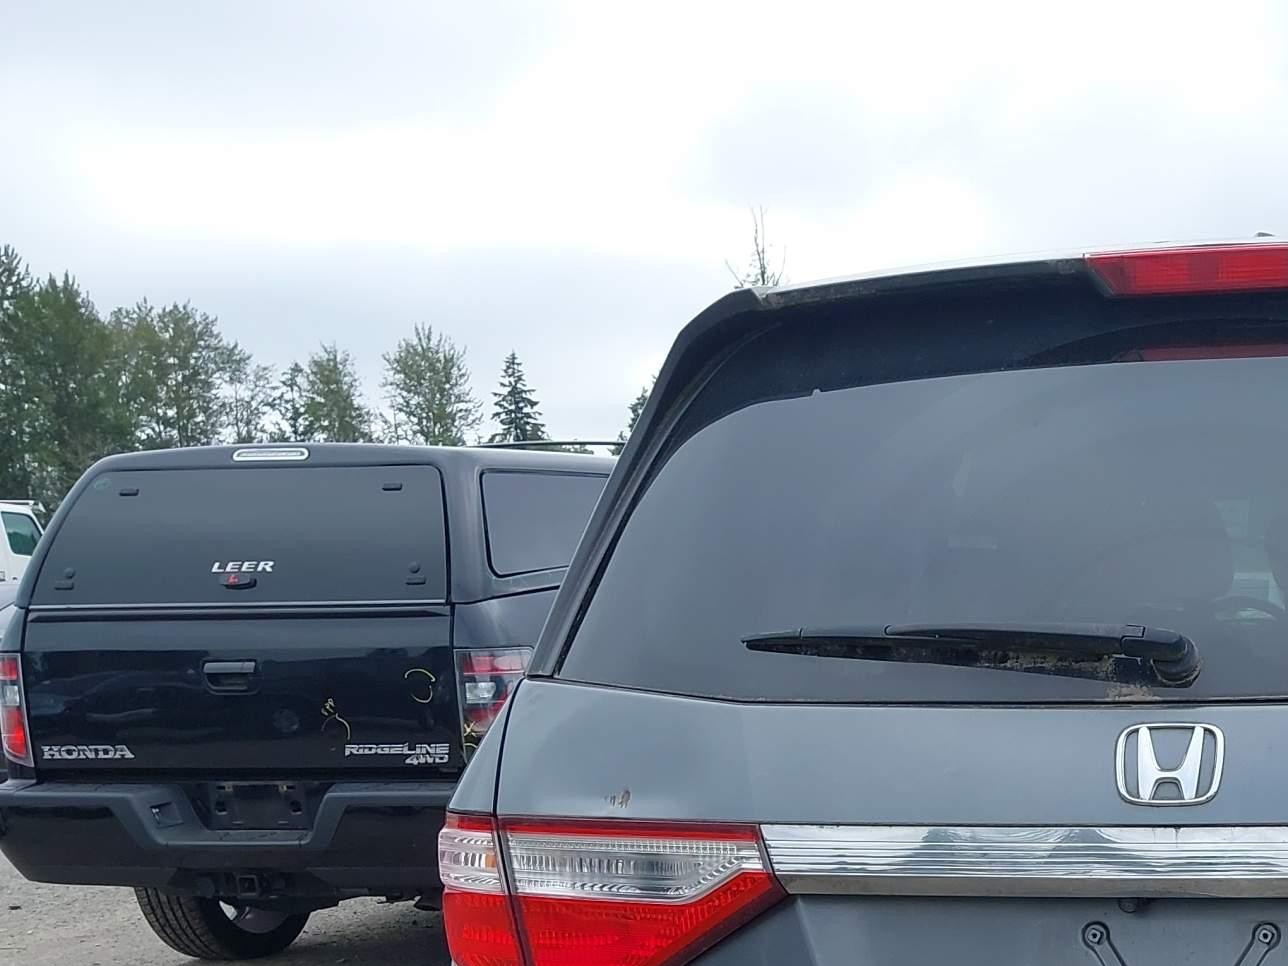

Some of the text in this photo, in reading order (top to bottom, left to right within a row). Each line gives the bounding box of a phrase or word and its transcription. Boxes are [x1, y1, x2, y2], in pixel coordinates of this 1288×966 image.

[210, 560, 275, 573] LEER
[41, 744, 135, 759] HONDA
[344, 742, 450, 757] RIDGELINE
[404, 753, 450, 765] 4WD
